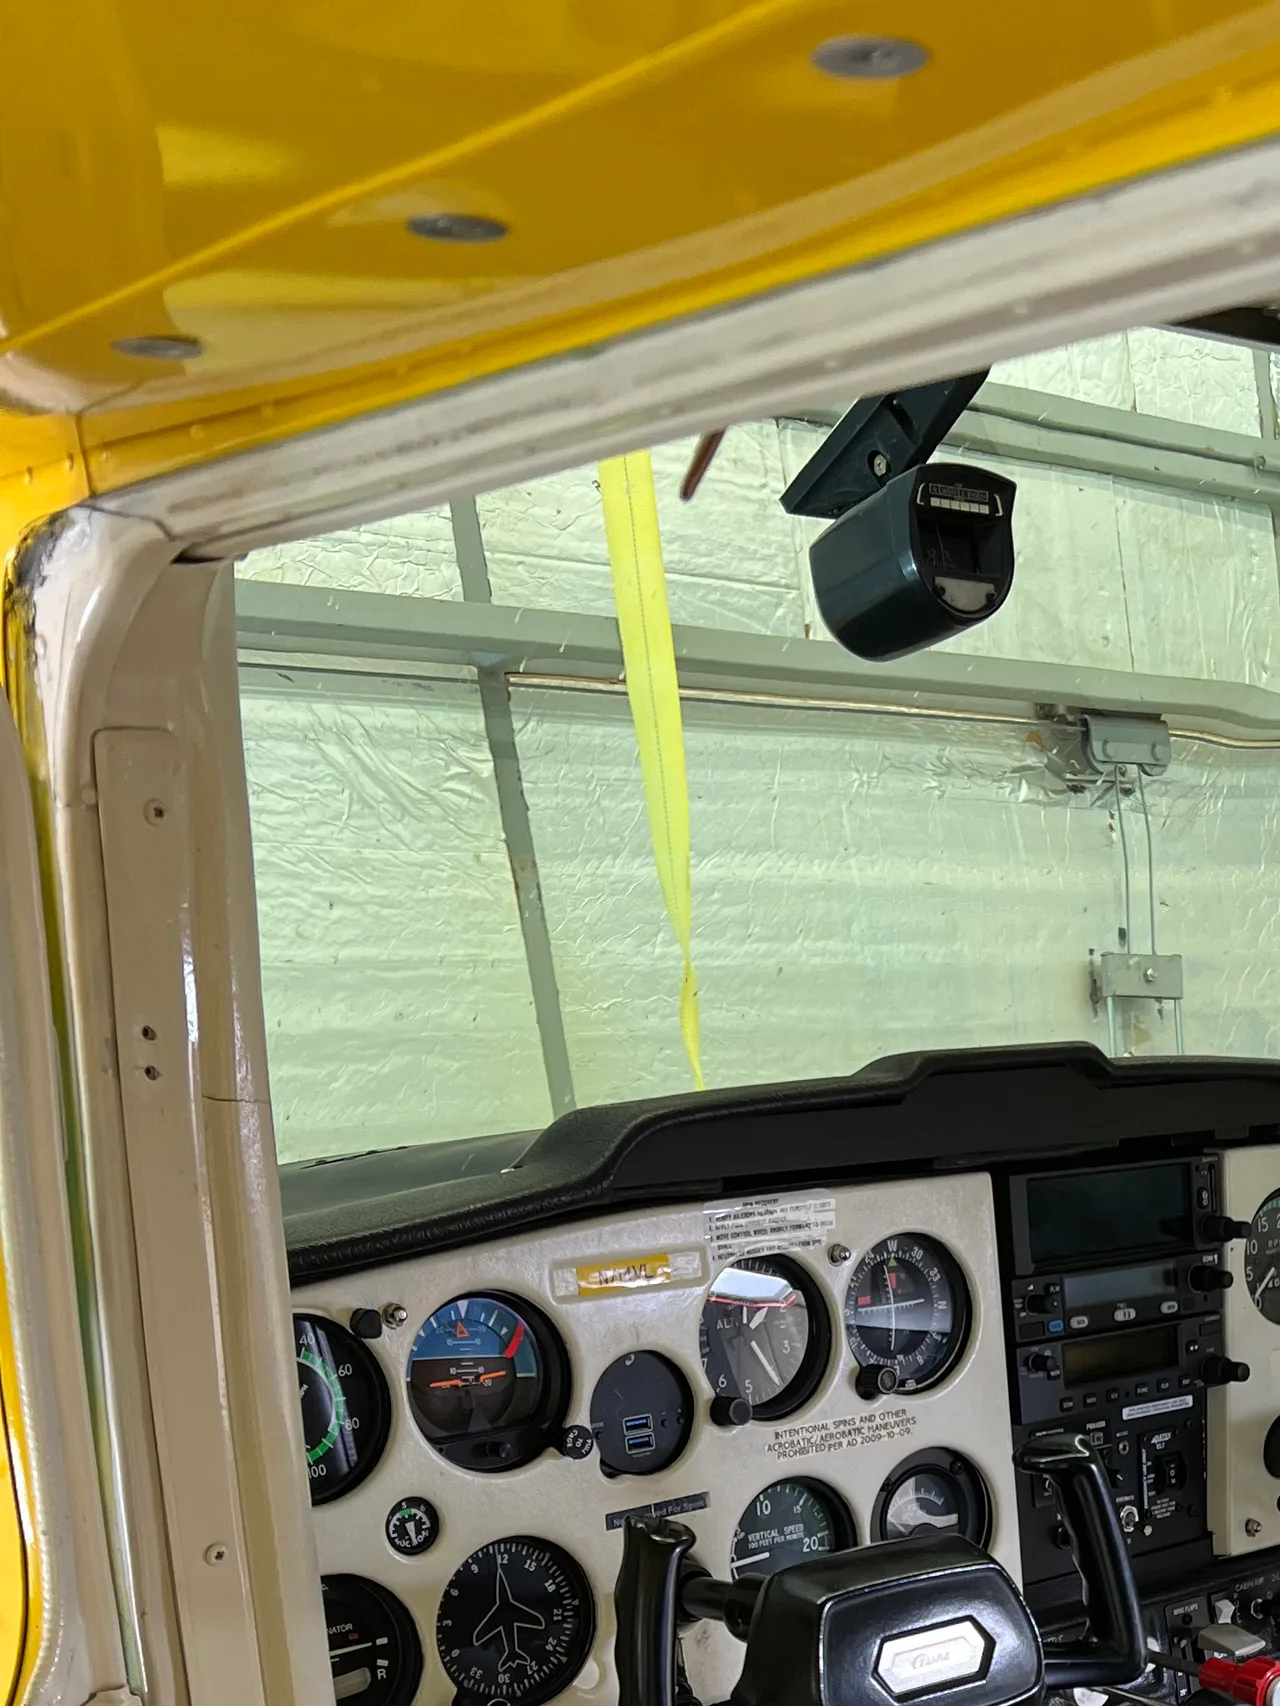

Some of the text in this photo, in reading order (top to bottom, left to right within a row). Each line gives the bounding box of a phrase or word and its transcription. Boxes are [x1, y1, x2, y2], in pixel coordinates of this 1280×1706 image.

[1257, 1217, 1269, 1233] 15
[886, 1239, 898, 1252] W
[1246, 1240, 1258, 1255] 10
[911, 1247, 924, 1261] 30
[929, 1267, 941, 1282] 33
[1246, 1266, 1253, 1281] 5
[937, 1300, 948, 1310] N
[299, 1333, 315, 1346] 40
[782, 1340, 790, 1354] 3
[338, 1363, 353, 1377] 60
[718, 1374, 727, 1388] 6
[744, 1380, 753, 1393] 5
[344, 1417, 360, 1430] 80
[774, 1408, 907, 1441] INTENTIONAL SPINS AND OTHER
[766, 1416, 917, 1453] ACROBATIC/AEROBATIC MANEUVERS
[777, 1443, 826, 1461] PROHIBITED
[827, 1440, 844, 1453] PER
[846, 1437, 858, 1448] AD
[668, 1505, 681, 1516] For
[683, 1500, 705, 1512] Spins
[756, 1500, 771, 1516] 10
[793, 1505, 802, 1514] 15
[747, 1523, 804, 1542] VERTICAL SPEED
[759, 1538, 772, 1547] FEET
[773, 1536, 785, 1544] PER
[786, 1531, 804, 1541] MINUTE
[802, 1536, 819, 1553] 20
[497, 1554, 509, 1564] 12
[523, 1559, 537, 1572] 15
[543, 1578, 557, 1593] 18
[553, 1608, 562, 1621] 21
[442, 1619, 453, 1627] 3
[545, 1636, 557, 1651] 24
[451, 1649, 460, 1658] 0
[377, 1668, 387, 1680] R
[469, 1666, 484, 1679] 33
[526, 1660, 539, 1676] 27
[498, 1673, 511, 1684] 30
